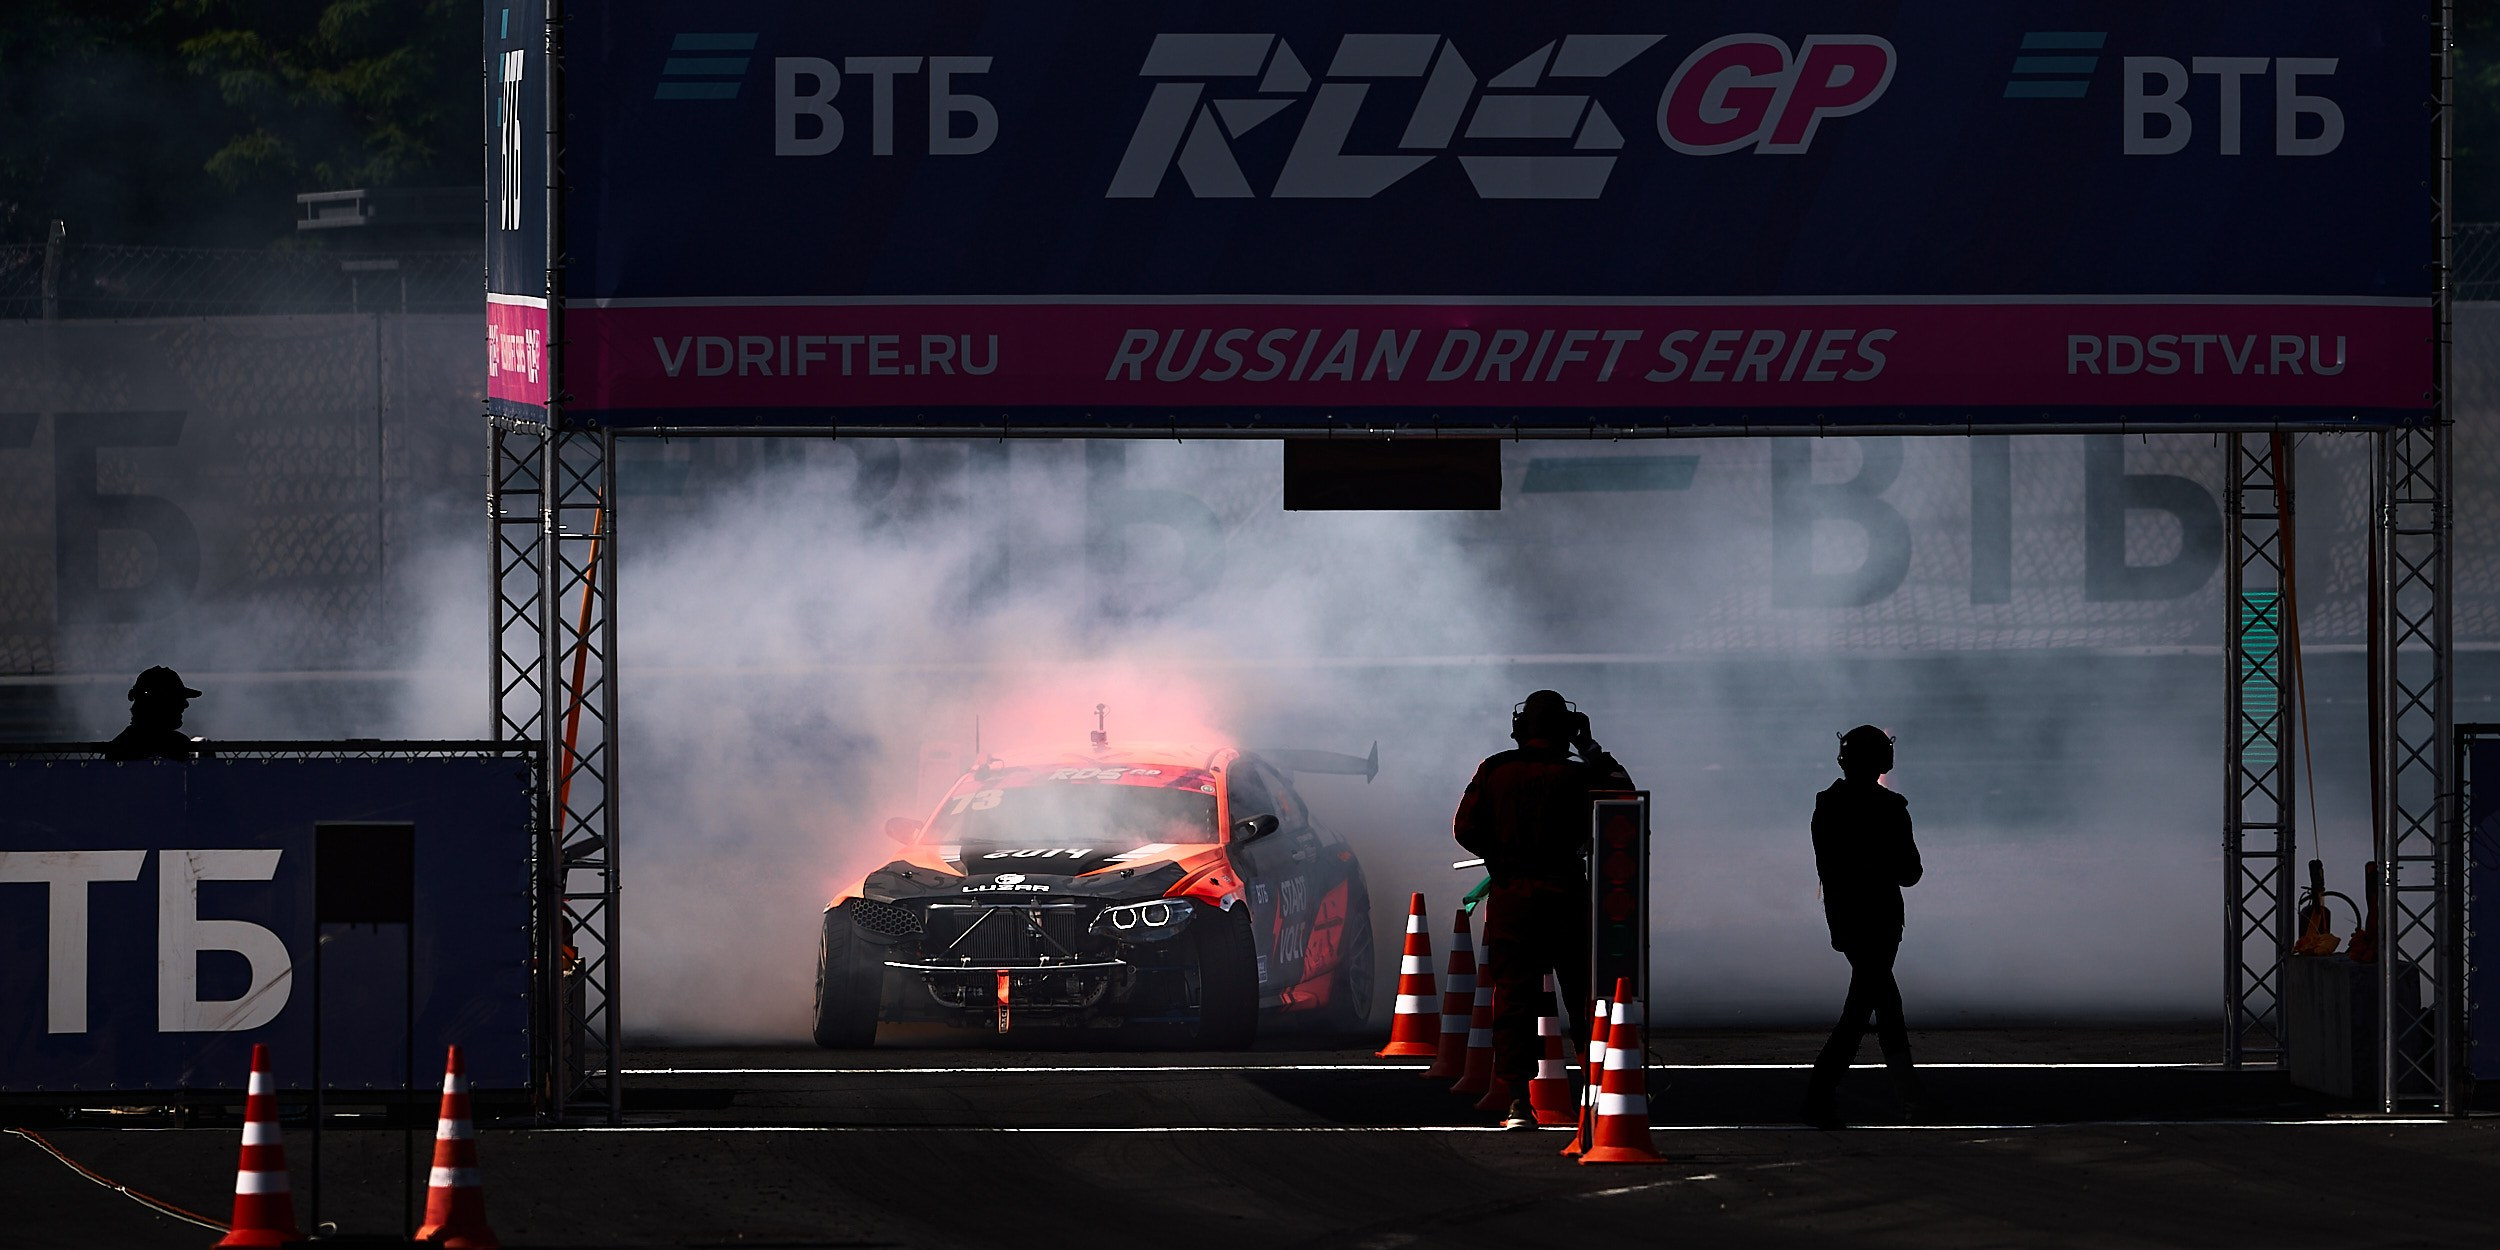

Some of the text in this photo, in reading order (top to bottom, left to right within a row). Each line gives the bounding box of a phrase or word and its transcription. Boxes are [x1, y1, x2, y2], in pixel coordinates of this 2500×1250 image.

[774, 56, 999, 156] ВТБ
[1105, 32, 1897, 199] RDS GP
[2122, 56, 2346, 156] ВТБ
[502, 49, 524, 230] ВТБ
[652, 333, 999, 377] VDRIFTE.RU
[1105, 328, 1898, 383] RUSSIAN DRIFT SERIES
[2067, 333, 2346, 376] RDSTV.RU
[1048, 767, 1130, 780] RDS
[962, 883, 1051, 893] LUZAR
[1281, 875, 1307, 917] START
[0, 848, 293, 1034] ТБ
[1280, 921, 1306, 963] VOLT
